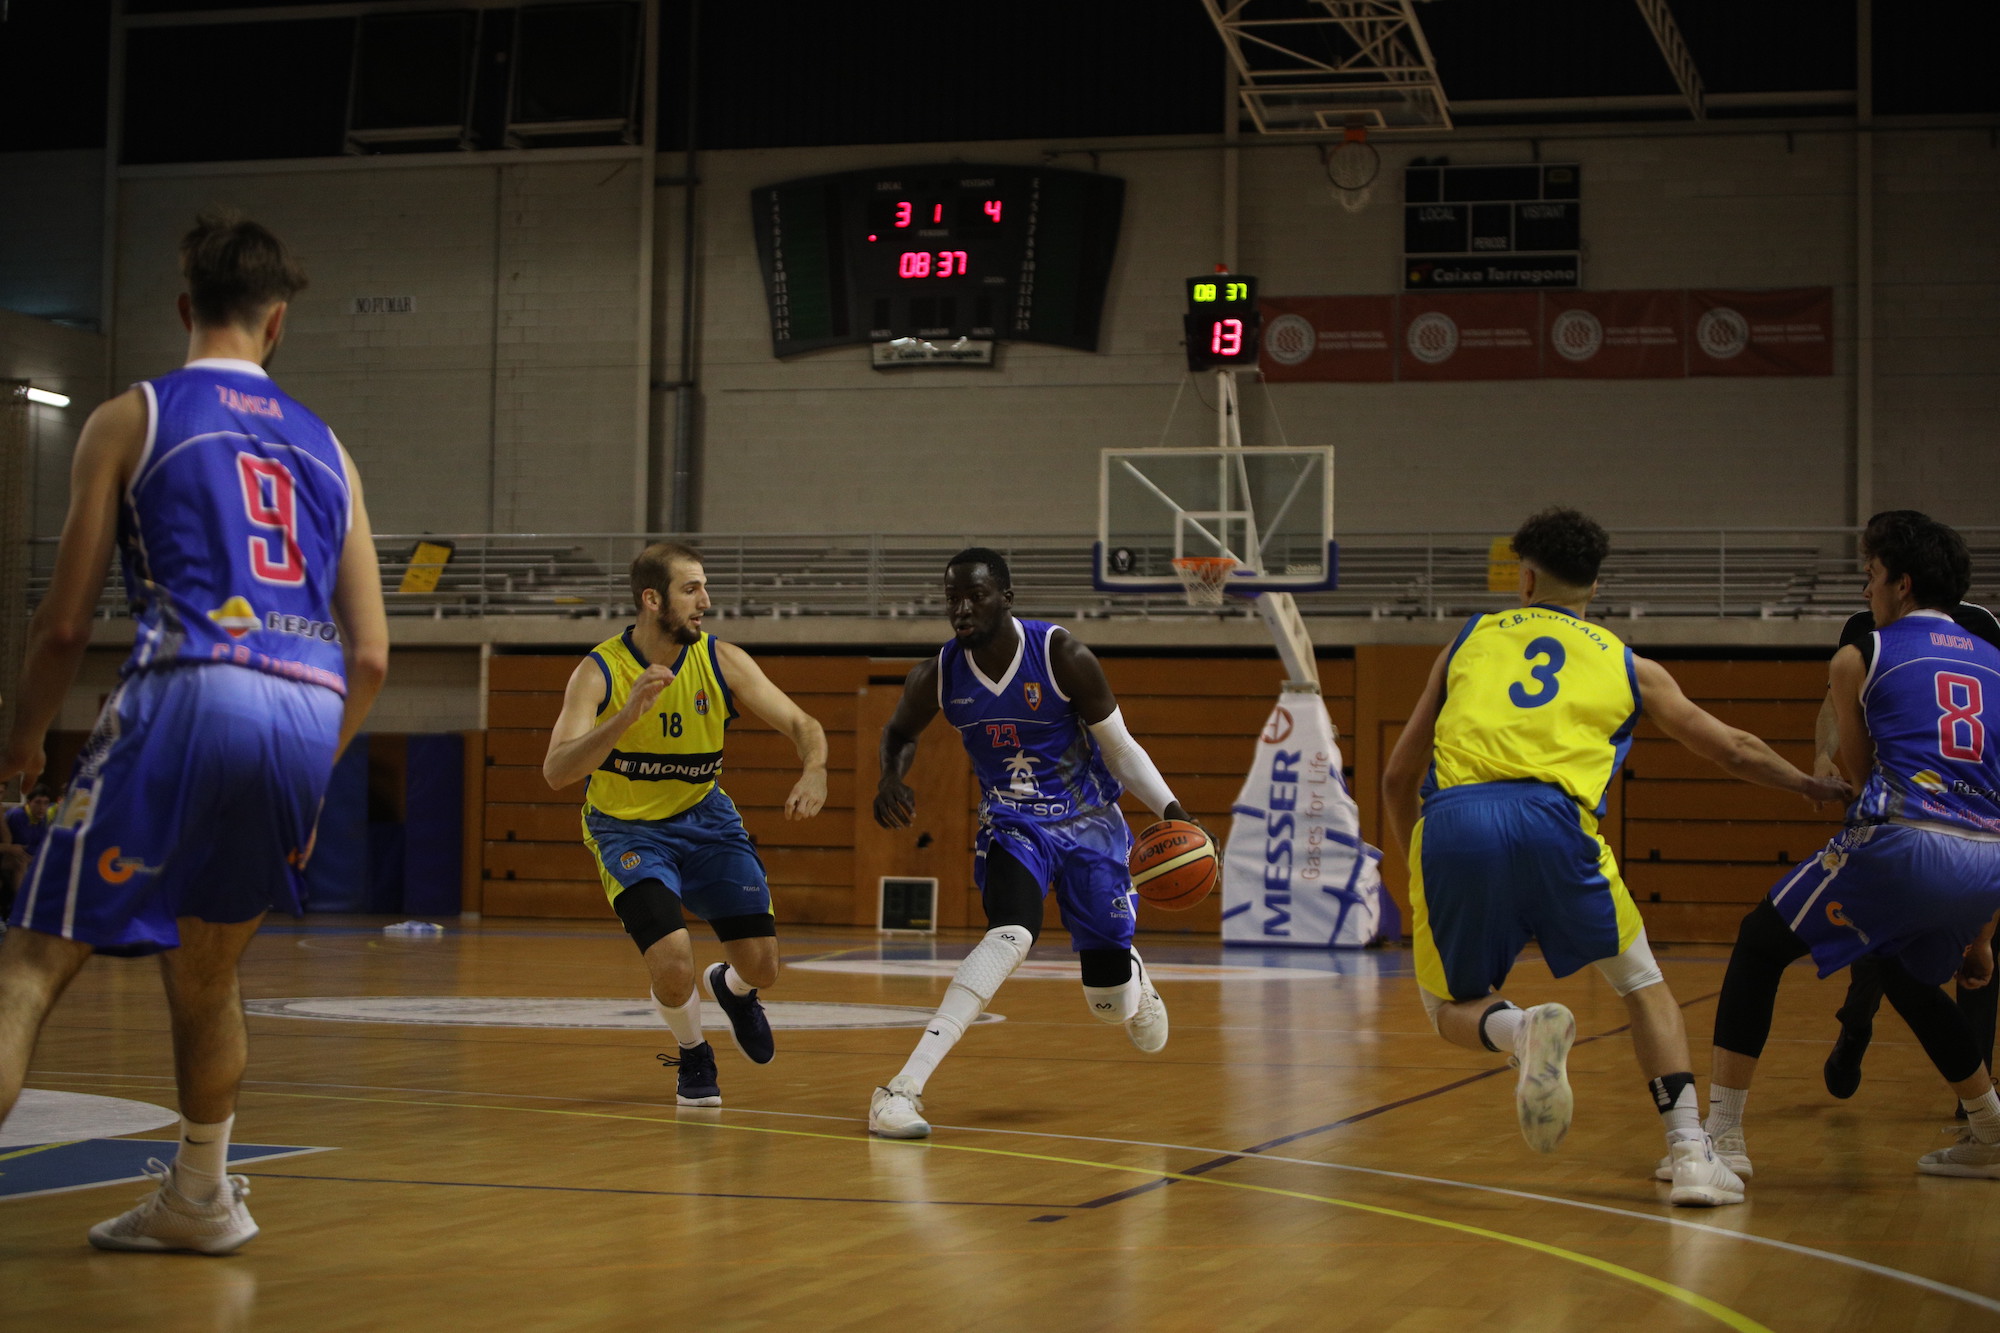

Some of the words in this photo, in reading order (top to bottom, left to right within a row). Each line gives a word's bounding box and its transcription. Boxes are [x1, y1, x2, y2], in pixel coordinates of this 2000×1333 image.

[893, 201, 912, 228] 3
[932, 203, 943, 224] 1
[982, 200, 1003, 223] 4
[1418, 206, 1456, 222] LOCAL
[1432, 267, 1484, 284] Caixa
[1487, 266, 1576, 286] Tarragona
[1211, 319, 1243, 356] 13
[236, 451, 307, 587] 9
[265, 610, 342, 645] REPSO
[1929, 632, 1975, 651] DUCH
[1508, 636, 1566, 708] 3
[659, 712, 683, 738] 18
[1934, 670, 1984, 764] 8
[985, 723, 1021, 749] 23
[1309, 751, 1329, 785] Life
[1306, 793, 1325, 821] for
[1139, 835, 1188, 863] molten
[1264, 749, 1302, 936] MESSER
[1301, 825, 1323, 881] Gases
